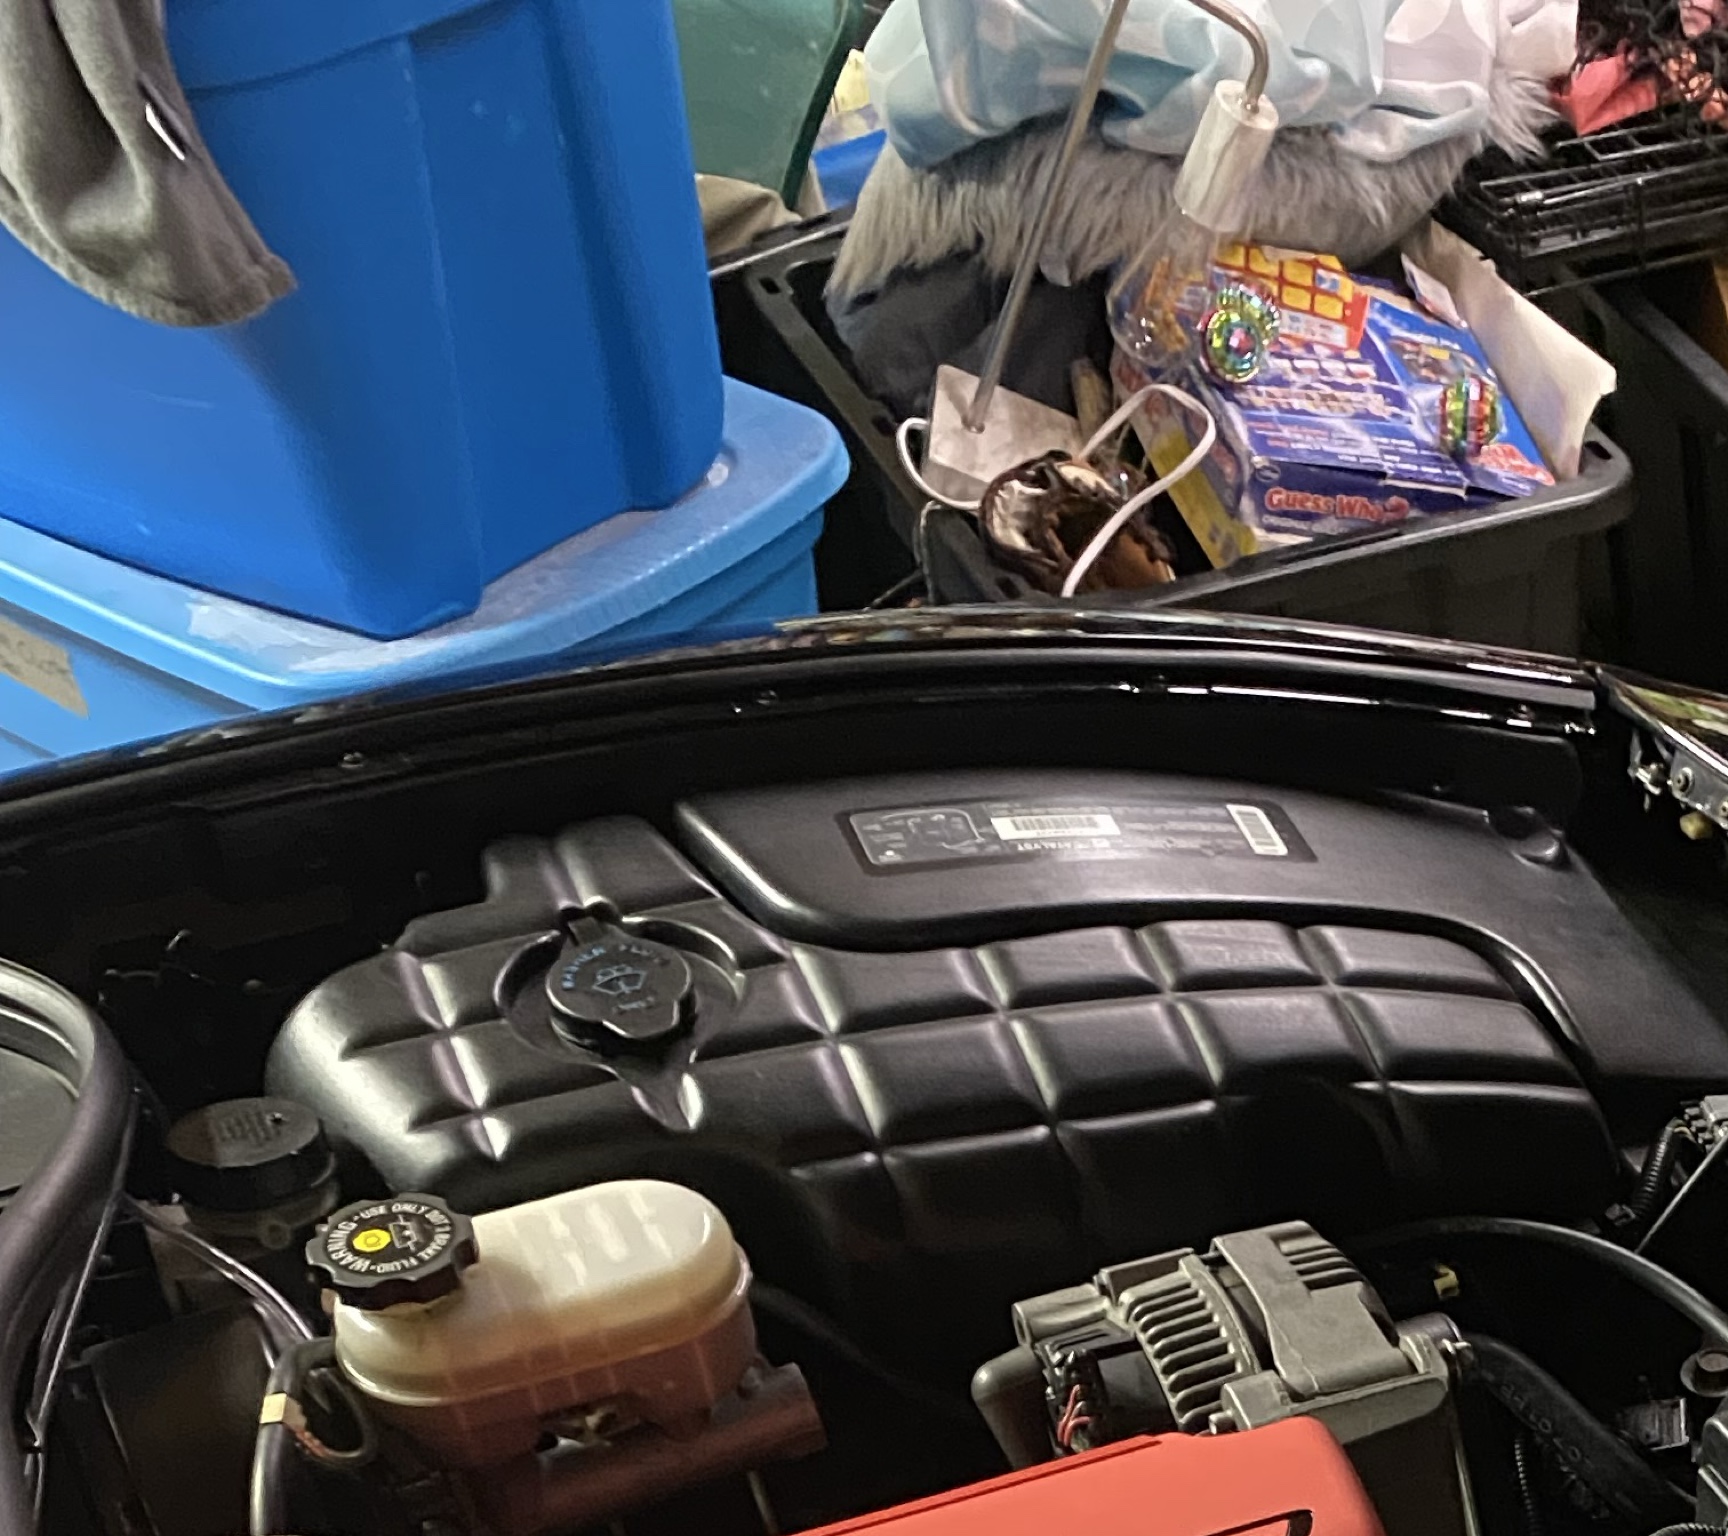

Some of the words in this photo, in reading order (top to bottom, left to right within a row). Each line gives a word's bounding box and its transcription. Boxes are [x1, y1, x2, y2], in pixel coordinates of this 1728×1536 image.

[1264, 486, 1335, 513] Guess
[1335, 493, 1410, 525] Who?
[327, 1221, 371, 1272] WARNING
[360, 1205, 388, 1219] USE
